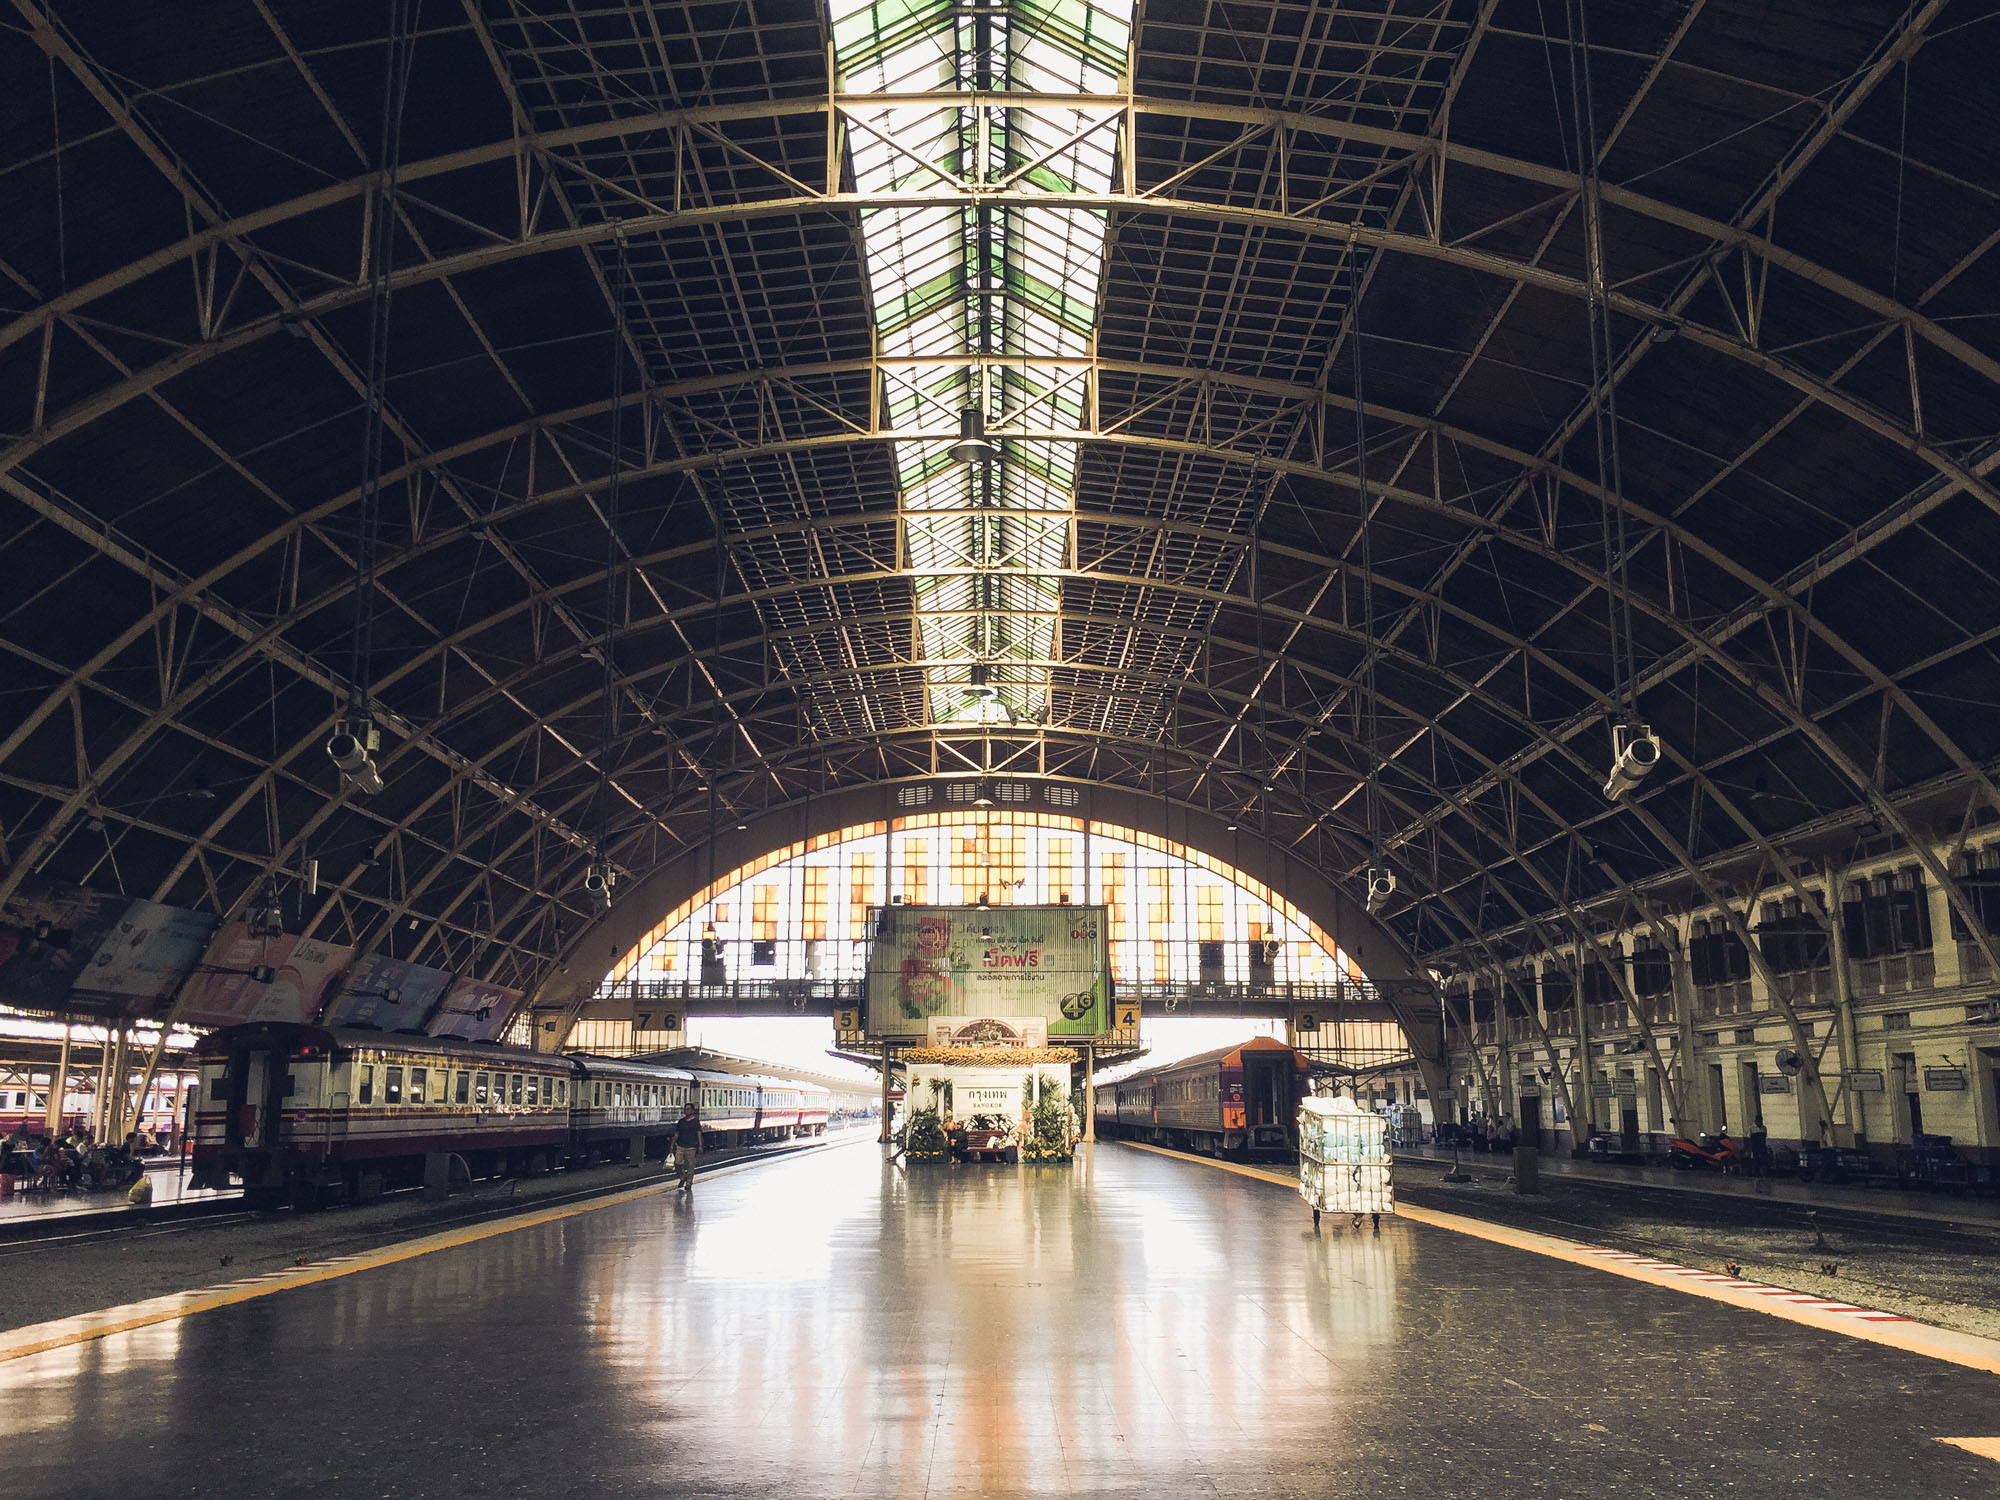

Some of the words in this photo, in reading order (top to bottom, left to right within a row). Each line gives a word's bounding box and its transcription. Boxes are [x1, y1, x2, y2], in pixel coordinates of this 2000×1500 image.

[639, 1013, 652, 1029] 7
[664, 1014, 676, 1029] 6
[840, 1012, 852, 1027] 5
[1122, 1011, 1135, 1026] 4
[1303, 1014, 1315, 1029] 3
[968, 1090, 1008, 1102] กรุงเทพ
